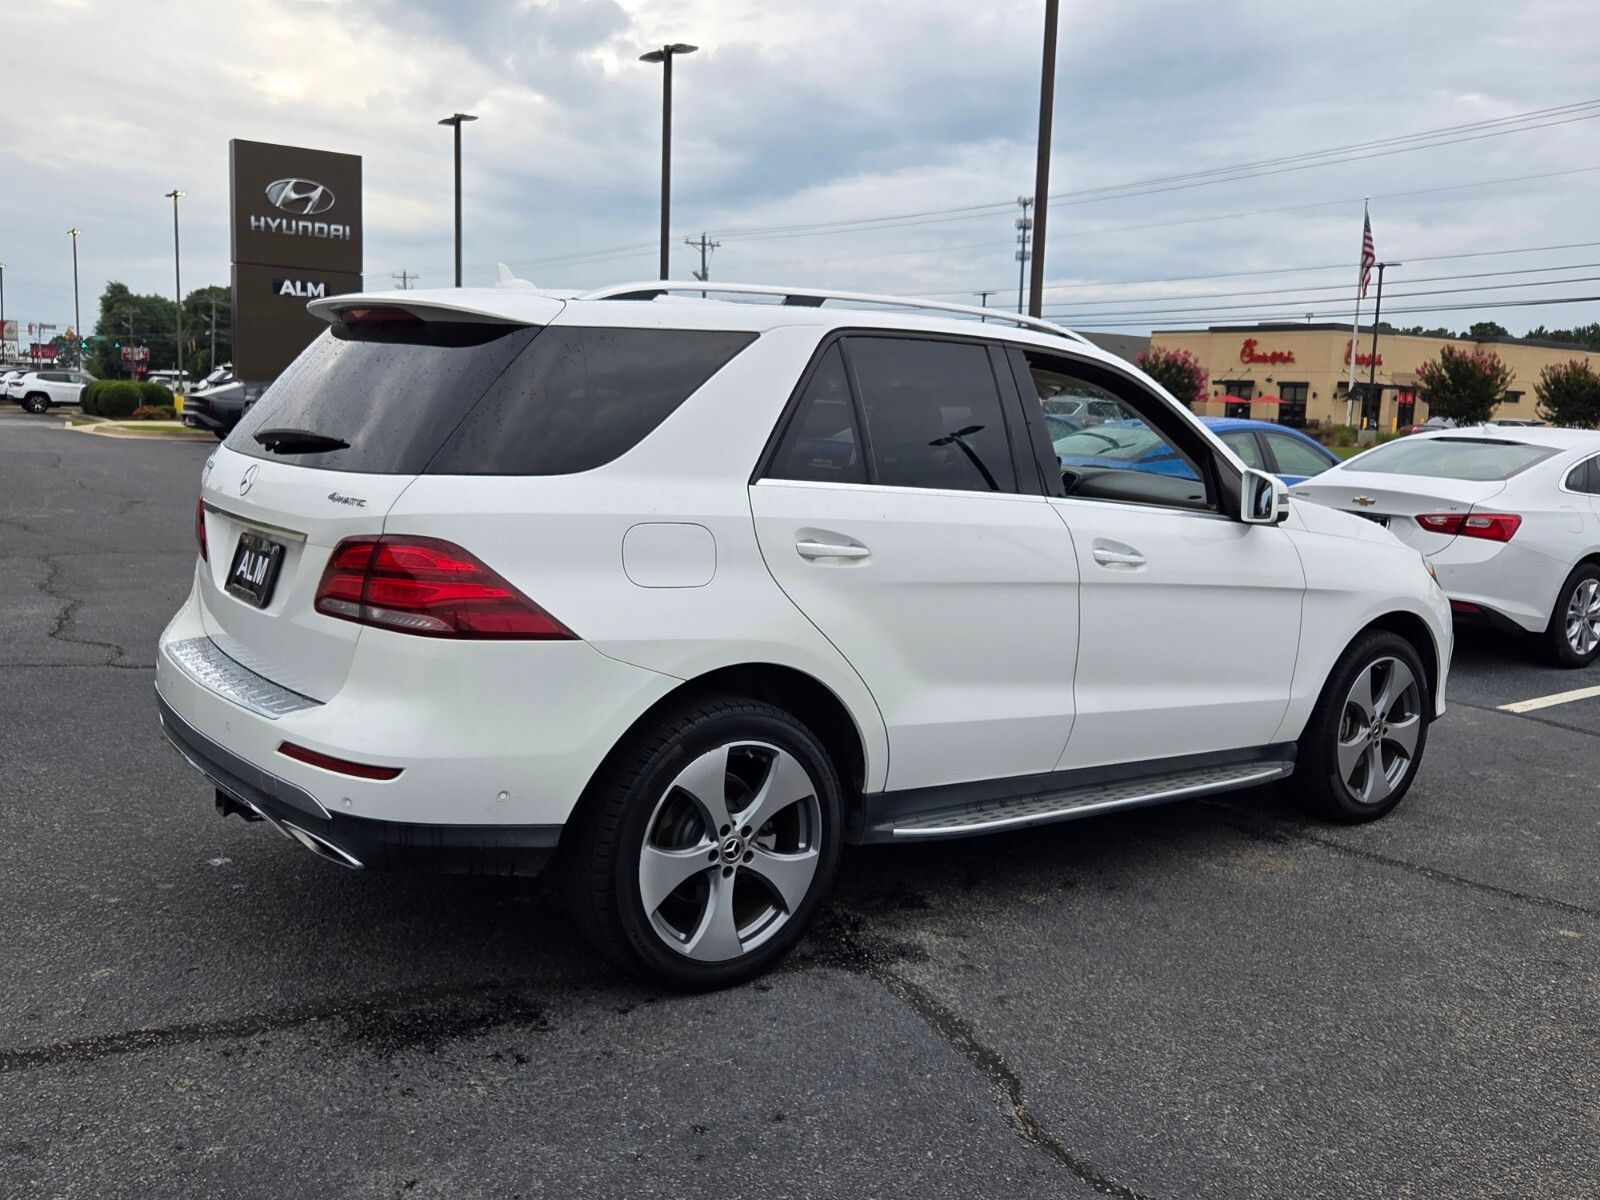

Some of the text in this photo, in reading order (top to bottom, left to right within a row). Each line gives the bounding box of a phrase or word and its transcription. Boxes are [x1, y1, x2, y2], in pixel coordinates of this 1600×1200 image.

[250, 215, 350, 240] HYUNDAI
[279, 280, 325, 298] ALM
[236, 549, 270, 586] ALM
